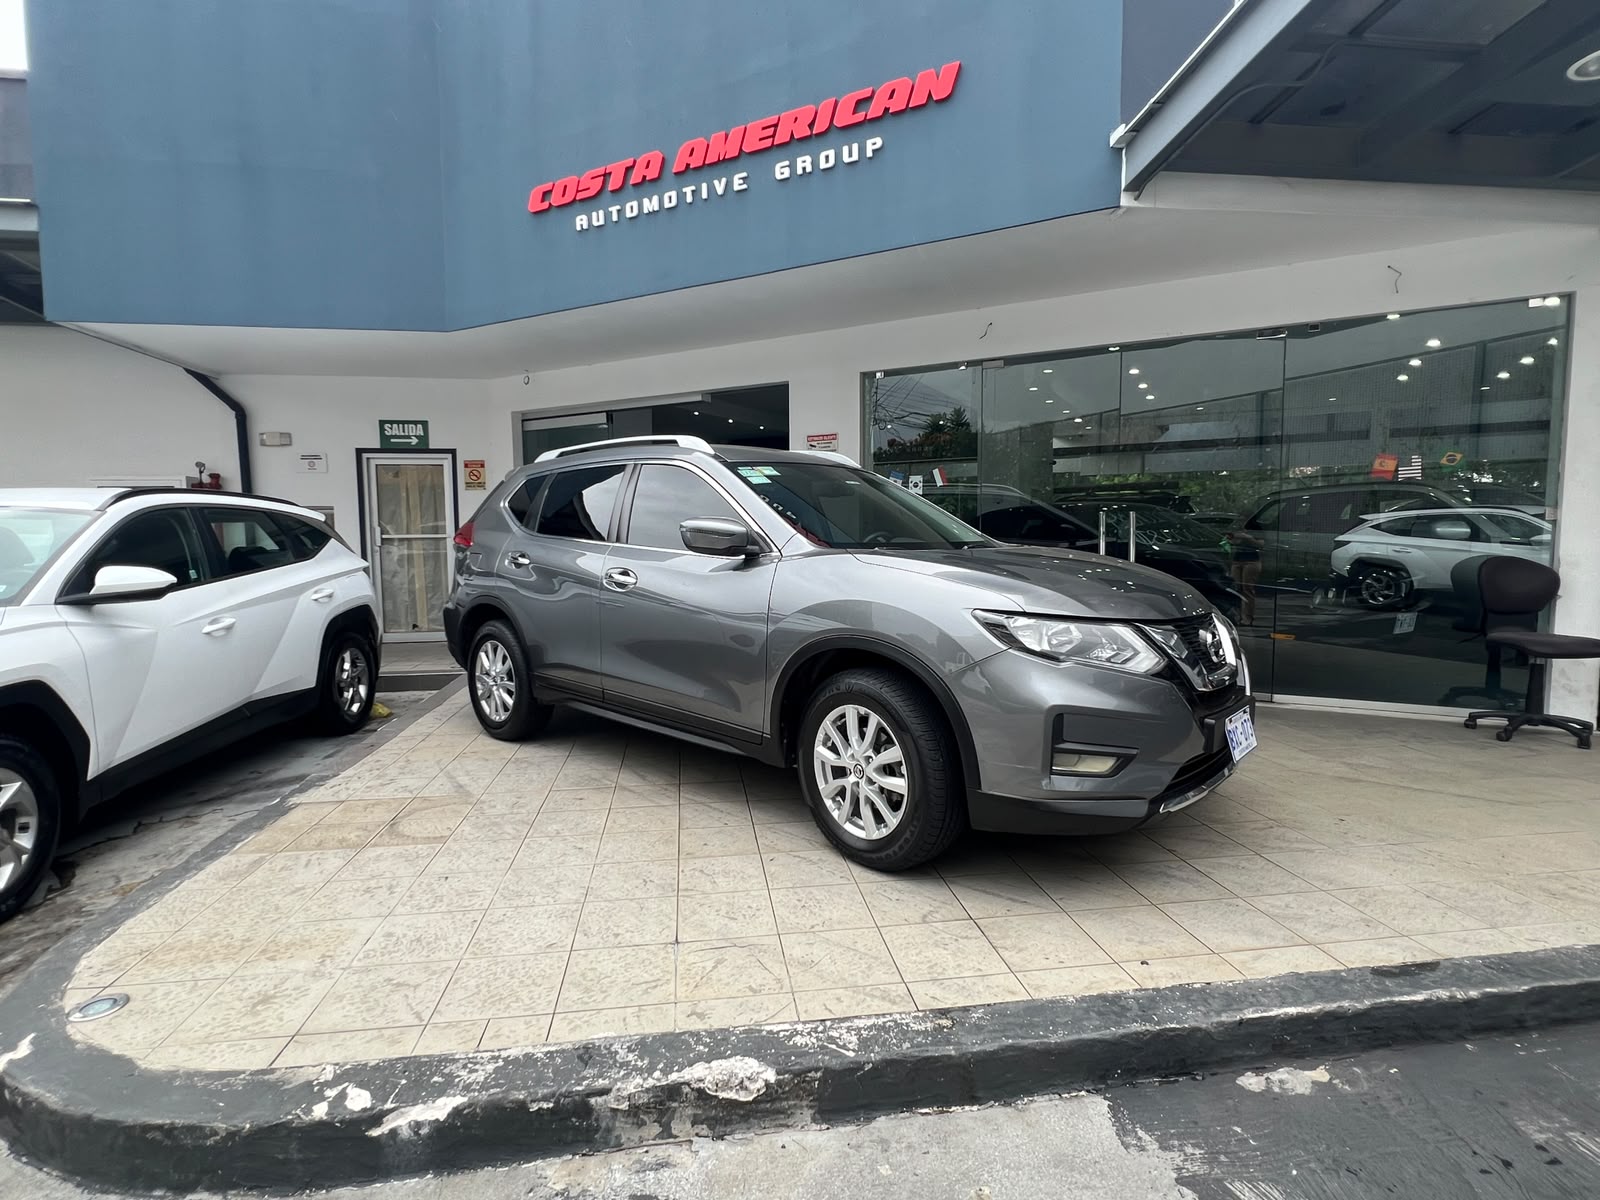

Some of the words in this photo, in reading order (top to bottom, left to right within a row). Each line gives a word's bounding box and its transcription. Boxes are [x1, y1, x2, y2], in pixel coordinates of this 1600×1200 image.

[527, 150, 665, 213] COSTA
[672, 60, 961, 174] AMERICAN
[575, 171, 748, 231] AUTOMOTIVE
[774, 136, 883, 180] GROUP
[384, 423, 424, 436] SALIDA
